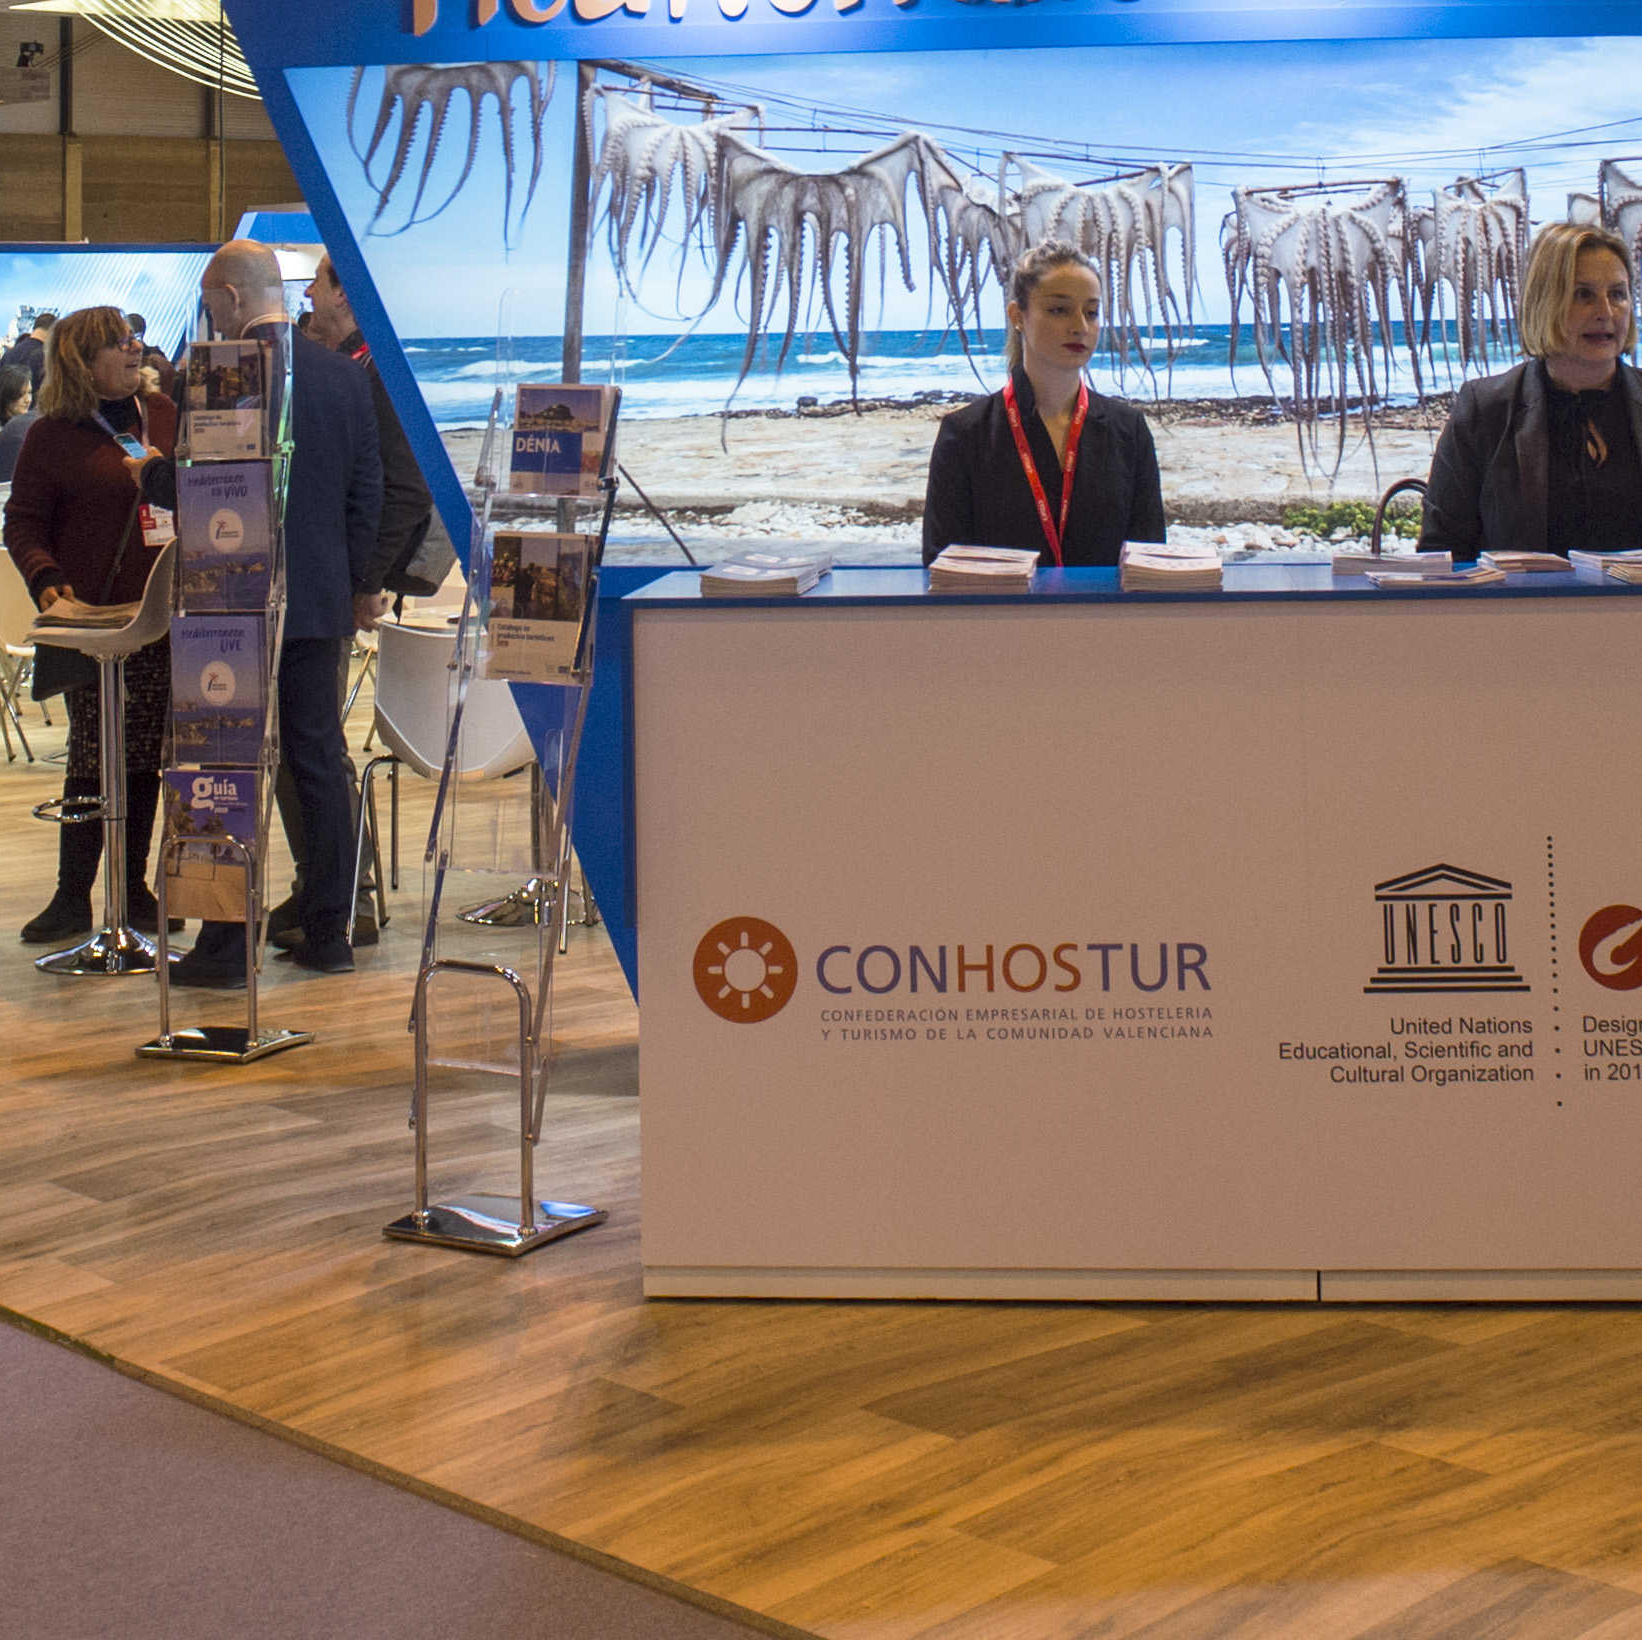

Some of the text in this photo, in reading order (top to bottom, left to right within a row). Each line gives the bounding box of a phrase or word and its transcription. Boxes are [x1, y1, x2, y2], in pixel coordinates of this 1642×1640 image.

[516, 434, 561, 453] DÉNIA
[1383, 902, 1508, 965] UNESCO
[816, 942, 1212, 995] CONHOSTUR
[966, 1008, 1078, 1022] EMPRESARIAL
[1085, 1008, 1106, 1021] DE
[821, 1025, 1214, 1041] Y TURISMO DE LA COMUNIDAD VALENCIANA
[1390, 1016, 1533, 1035] United Nations
[1279, 1041, 1534, 1061] Educational, Scientific and
[1330, 1065, 1534, 1086] Cultural Organization
[1584, 1064, 1601, 1081] in
